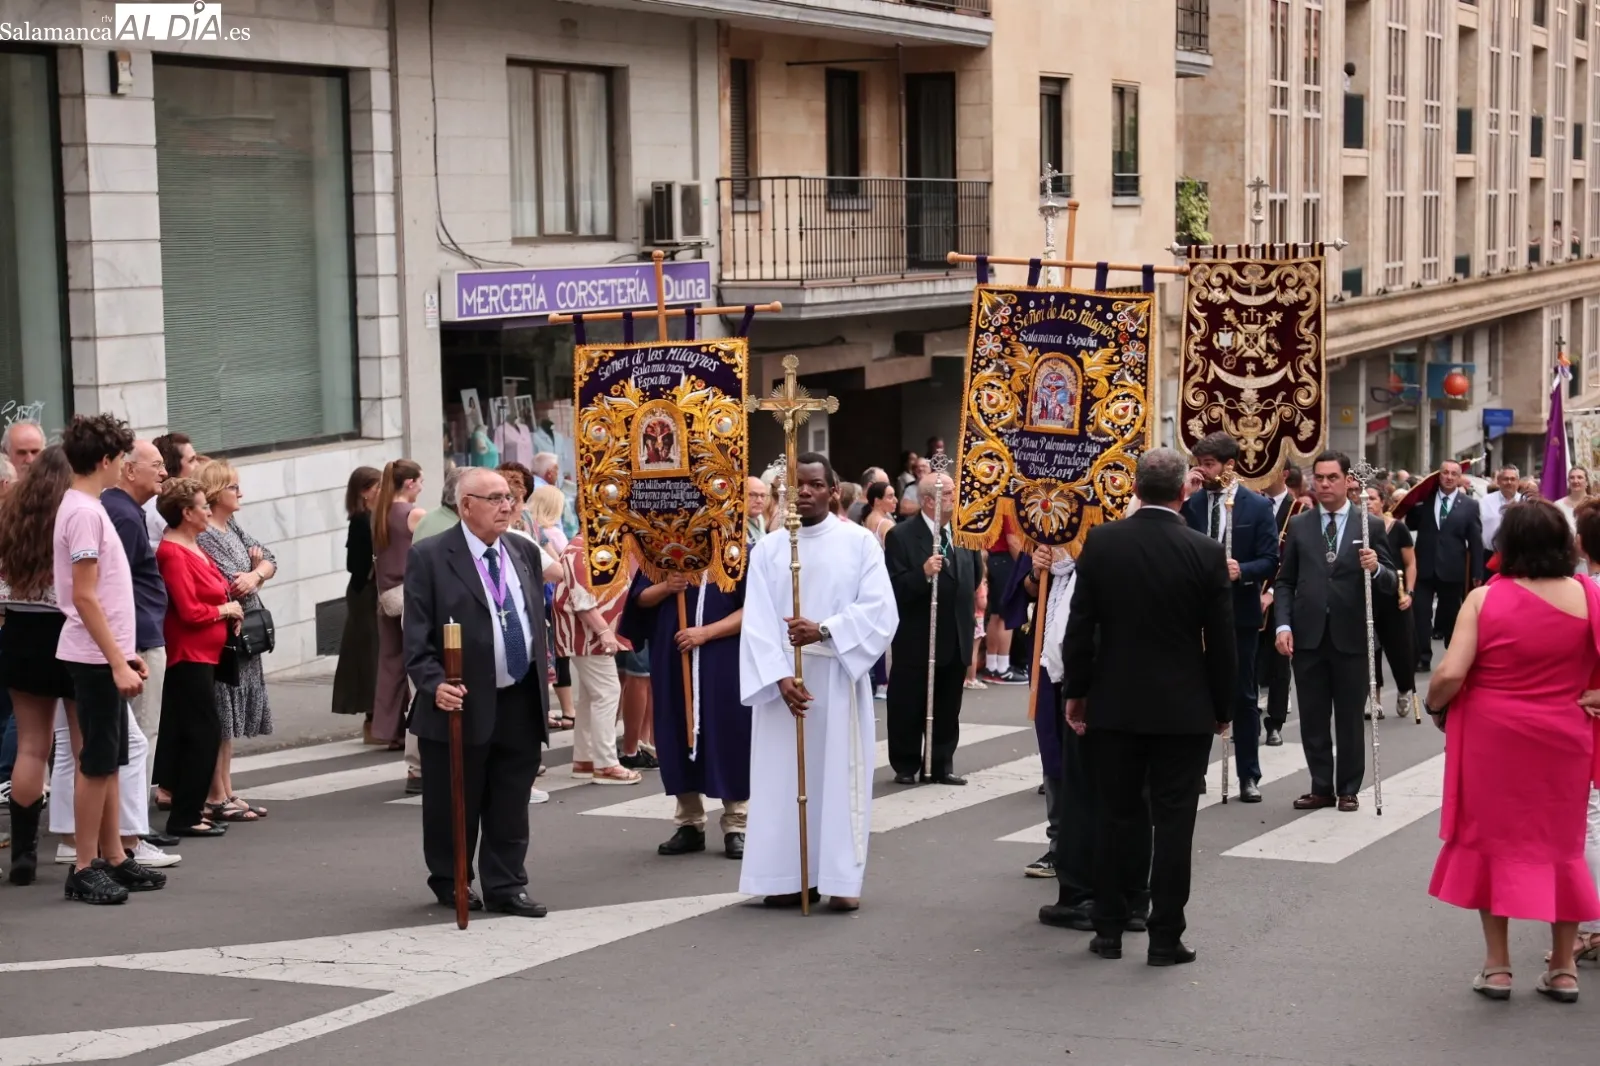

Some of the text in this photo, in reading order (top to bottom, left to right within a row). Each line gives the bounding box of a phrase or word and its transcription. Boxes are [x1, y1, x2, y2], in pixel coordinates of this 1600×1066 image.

[462, 270, 706, 315] MERCERÍA CORSETERÍA Duna
[1013, 308, 1045, 331] Señor
[1046, 301, 1057, 320] de
[1073, 308, 1117, 339] Milagros
[1019, 329, 1098, 349] Salamanca España
[632, 349, 645, 366] de
[665, 347, 720, 372] Milagros
[637, 374, 671, 390] España
